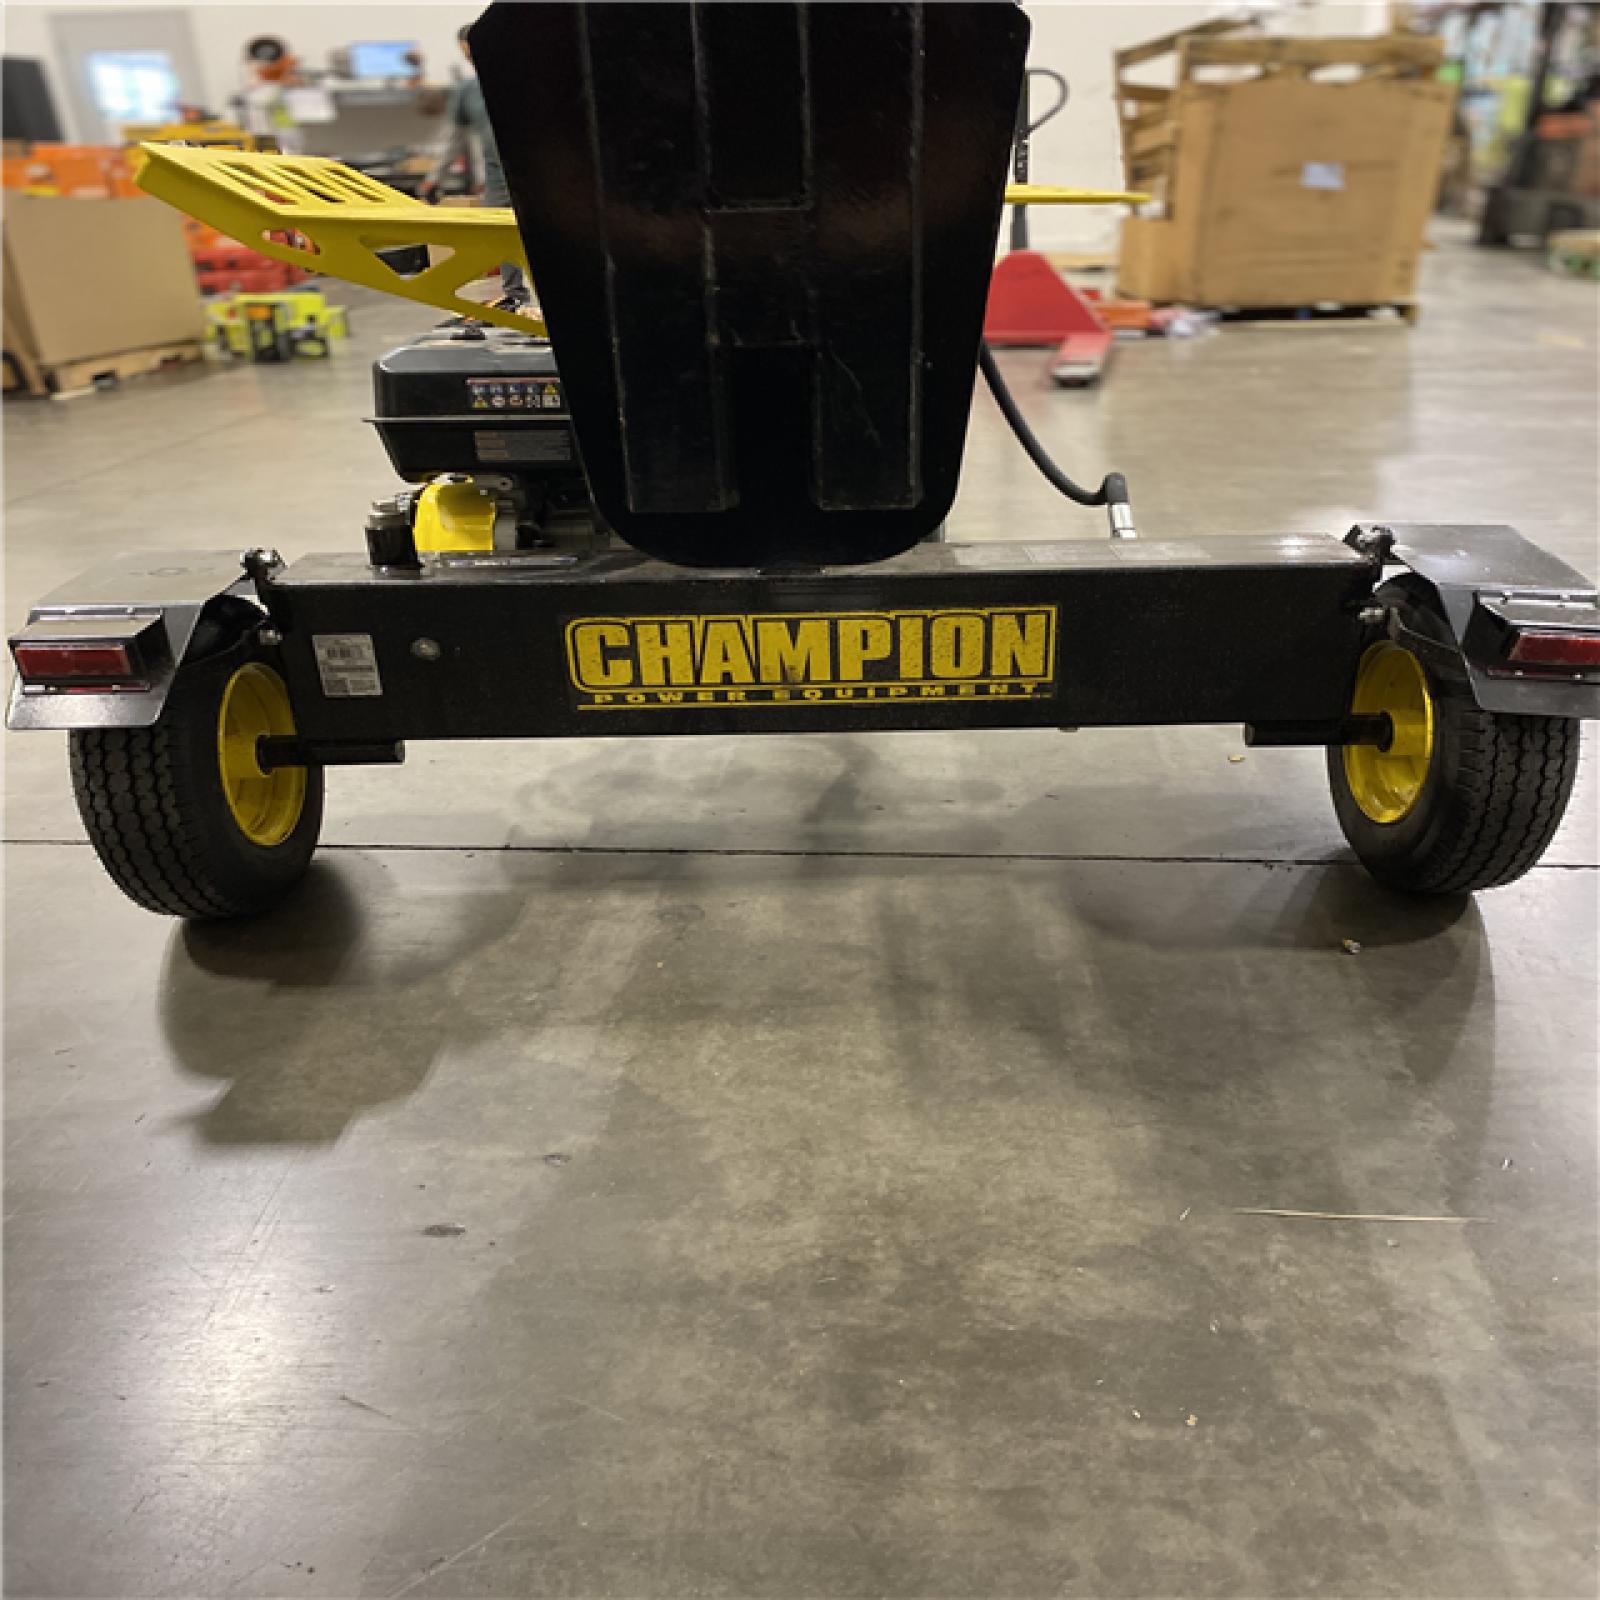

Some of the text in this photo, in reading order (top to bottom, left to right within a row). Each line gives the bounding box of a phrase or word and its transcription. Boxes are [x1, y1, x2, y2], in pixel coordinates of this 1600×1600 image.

[576, 614, 1047, 685] CHAMPION
[594, 683, 1039, 703] POWER EQUIPMENT
